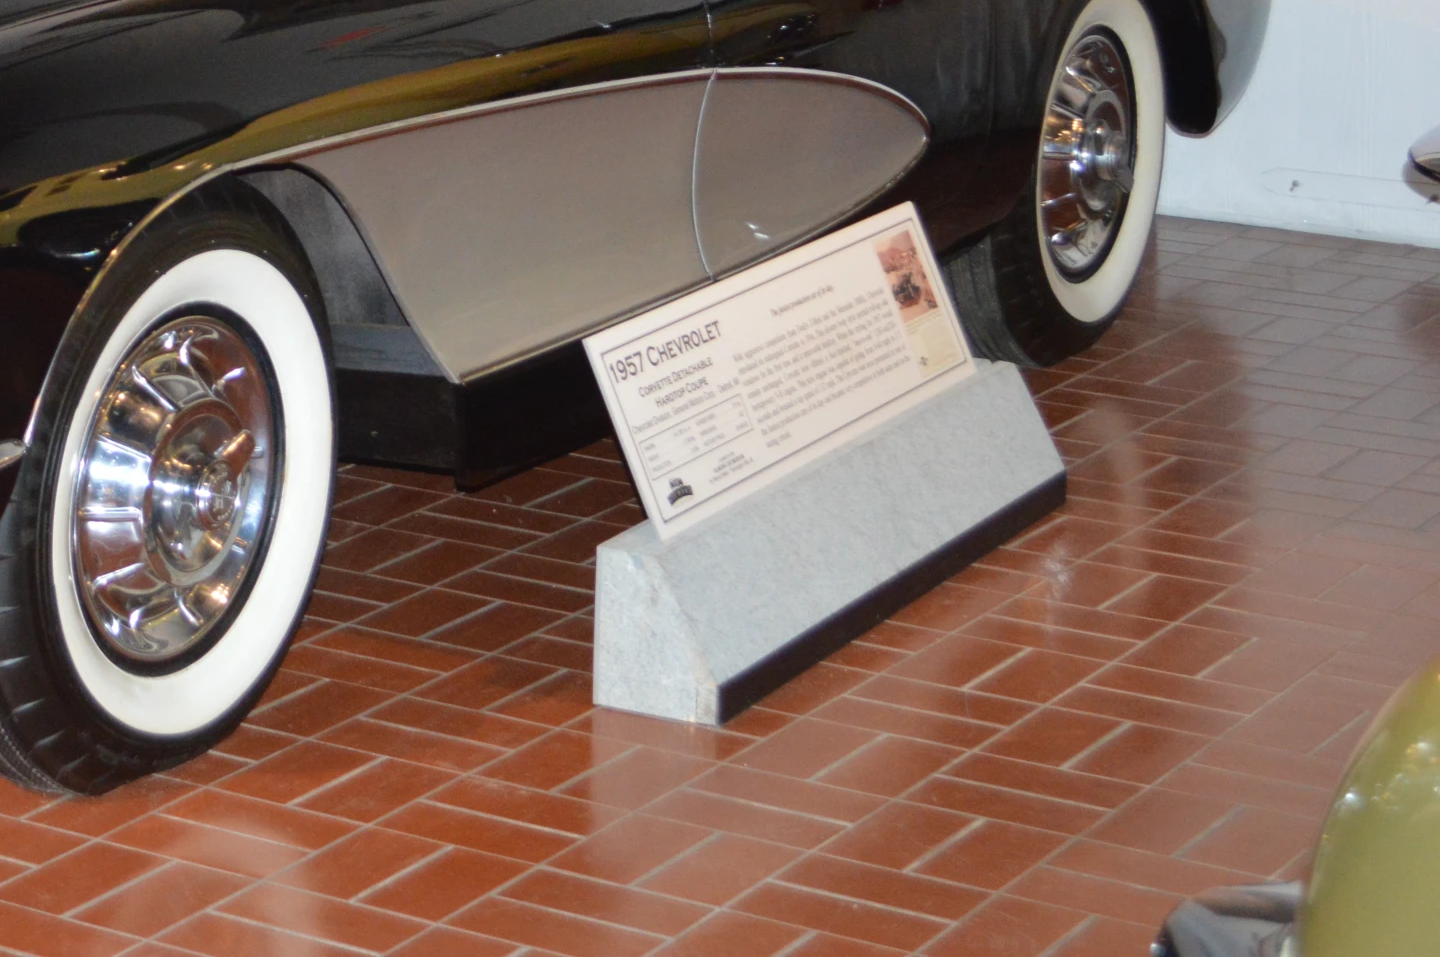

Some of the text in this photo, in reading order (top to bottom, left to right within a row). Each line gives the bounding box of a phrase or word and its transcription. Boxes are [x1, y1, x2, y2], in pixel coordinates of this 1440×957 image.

[609, 320, 722, 384] 1957 CHEVROLET
[638, 357, 713, 398] CORVETTE DETACHABLE
[655, 376, 709, 408] HARDTOP COUPE
